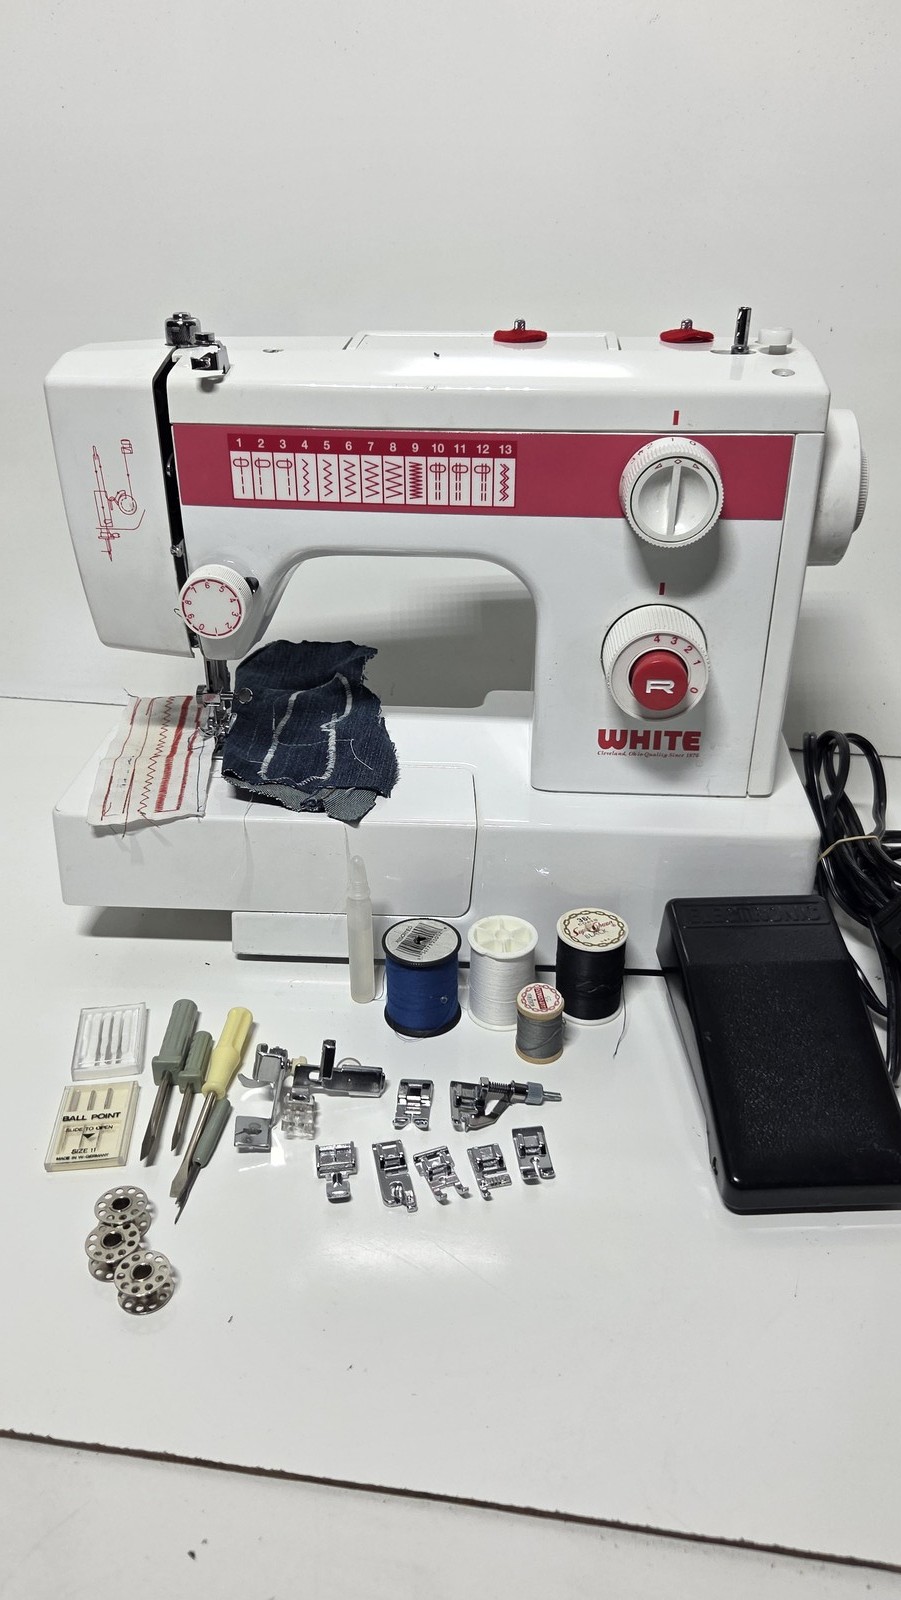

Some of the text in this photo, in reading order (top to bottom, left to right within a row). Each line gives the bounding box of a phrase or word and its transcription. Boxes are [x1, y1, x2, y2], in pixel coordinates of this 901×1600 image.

[236, 437, 512, 455] 1 2 3 4 5 6 7 8 9 10 11 12 13
[204, 581, 211, 589] 6
[218, 585, 226, 593] 5
[190, 586, 198, 594] 7
[198, 623, 206, 631] 0
[653, 635, 661, 643] 4
[670, 636, 679, 645] 3
[683, 645, 693, 654] 2
[689, 686, 698, 694] 0
[645, 680, 675, 694] R
[597, 728, 702, 752] WHITE
[91, 1112, 121, 1120] POINT
[71, 1147, 88, 1155] SIZE
